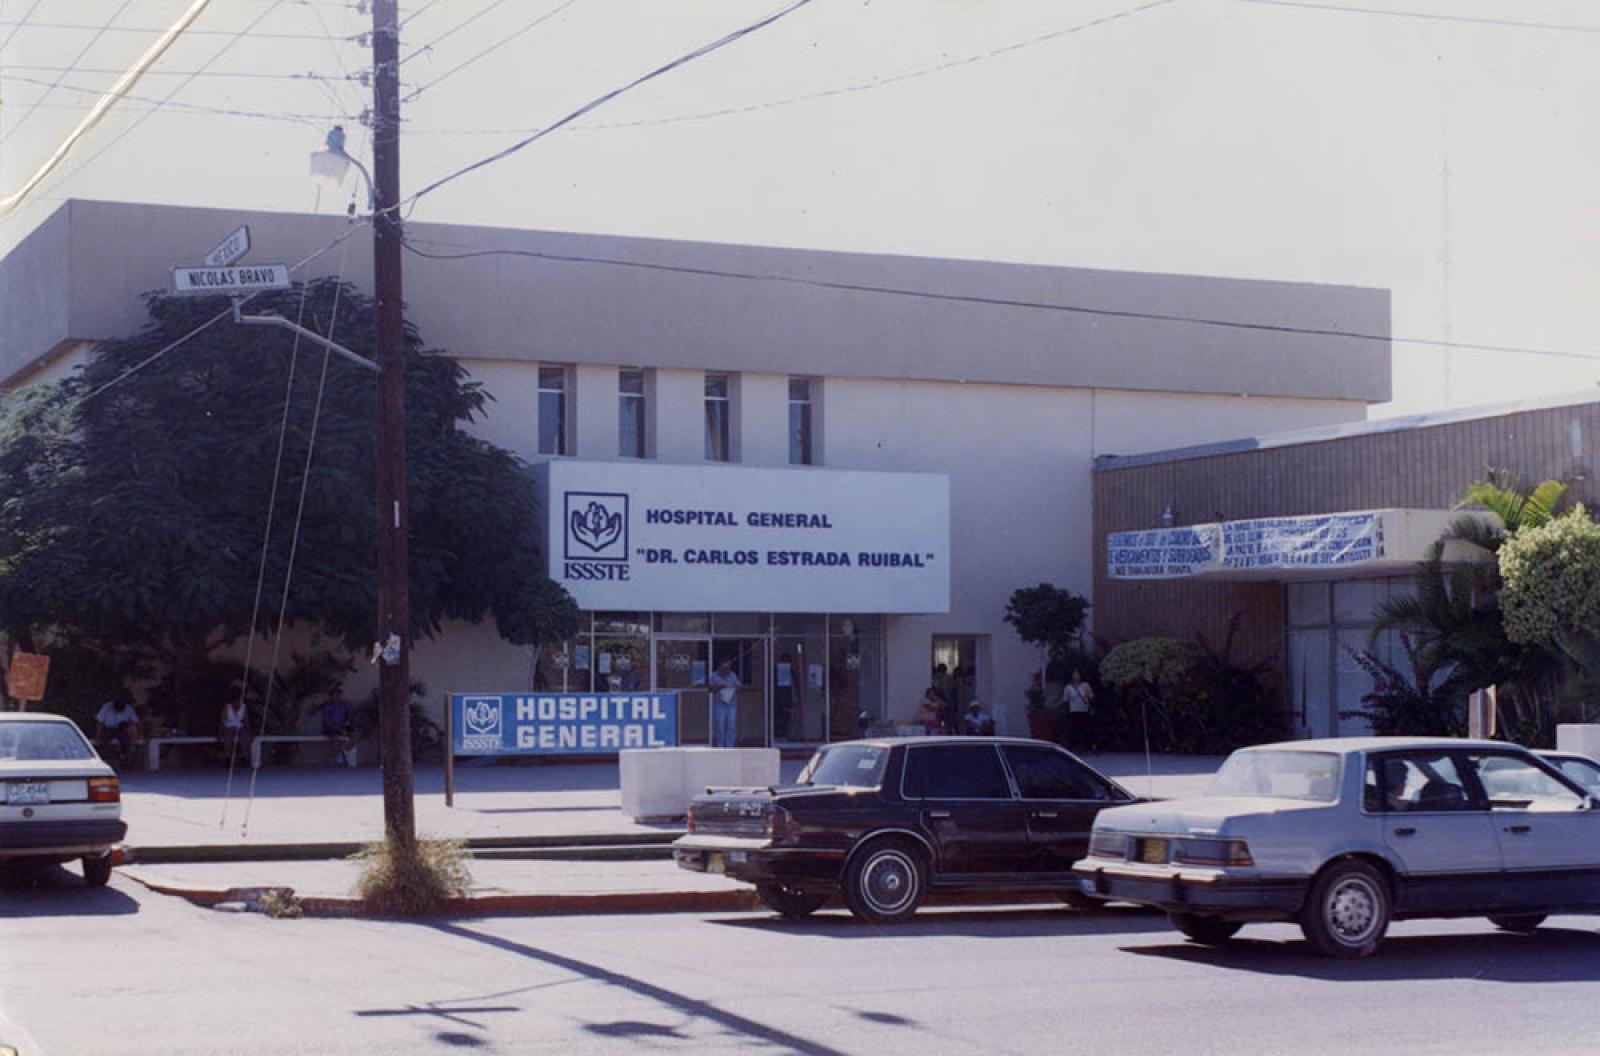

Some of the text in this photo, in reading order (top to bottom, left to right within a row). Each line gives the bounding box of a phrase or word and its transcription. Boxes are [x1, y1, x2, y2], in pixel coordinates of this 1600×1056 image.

[188, 268, 275, 286] NICOLAS BRAVO
[646, 508, 833, 529] HOSPITAL GENERAL
[636, 548, 934, 569] "DR. CARLOS ESTRADA RUIBAL"
[564, 562, 630, 581] ISSSTE
[516, 697, 666, 721] HOSPITAL
[516, 724, 666, 748] GENERAL
